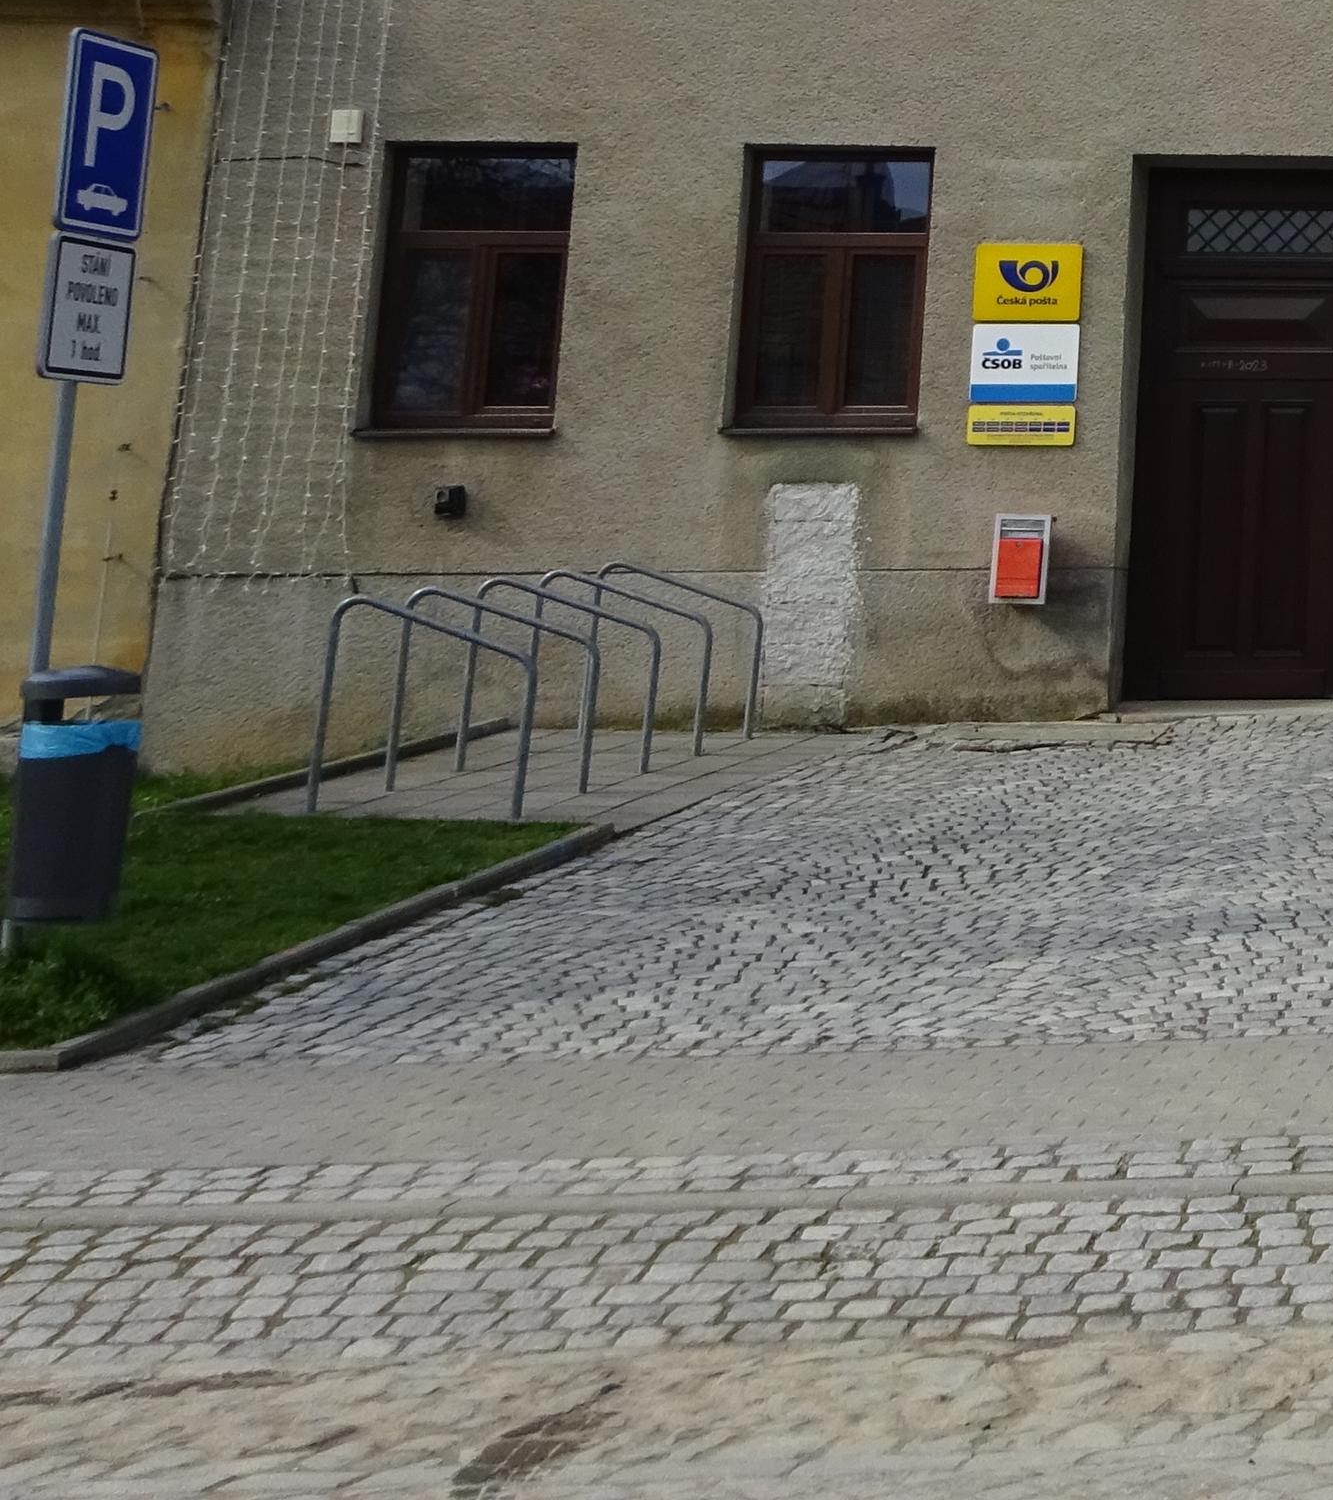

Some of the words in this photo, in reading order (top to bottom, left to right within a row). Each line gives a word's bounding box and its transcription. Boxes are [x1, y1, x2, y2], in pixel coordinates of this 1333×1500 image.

[83, 60, 136, 168] P
[996, 294, 1027, 306] Česká
[1029, 295, 1058, 307] pošta
[981, 357, 1023, 370] ČSOB
